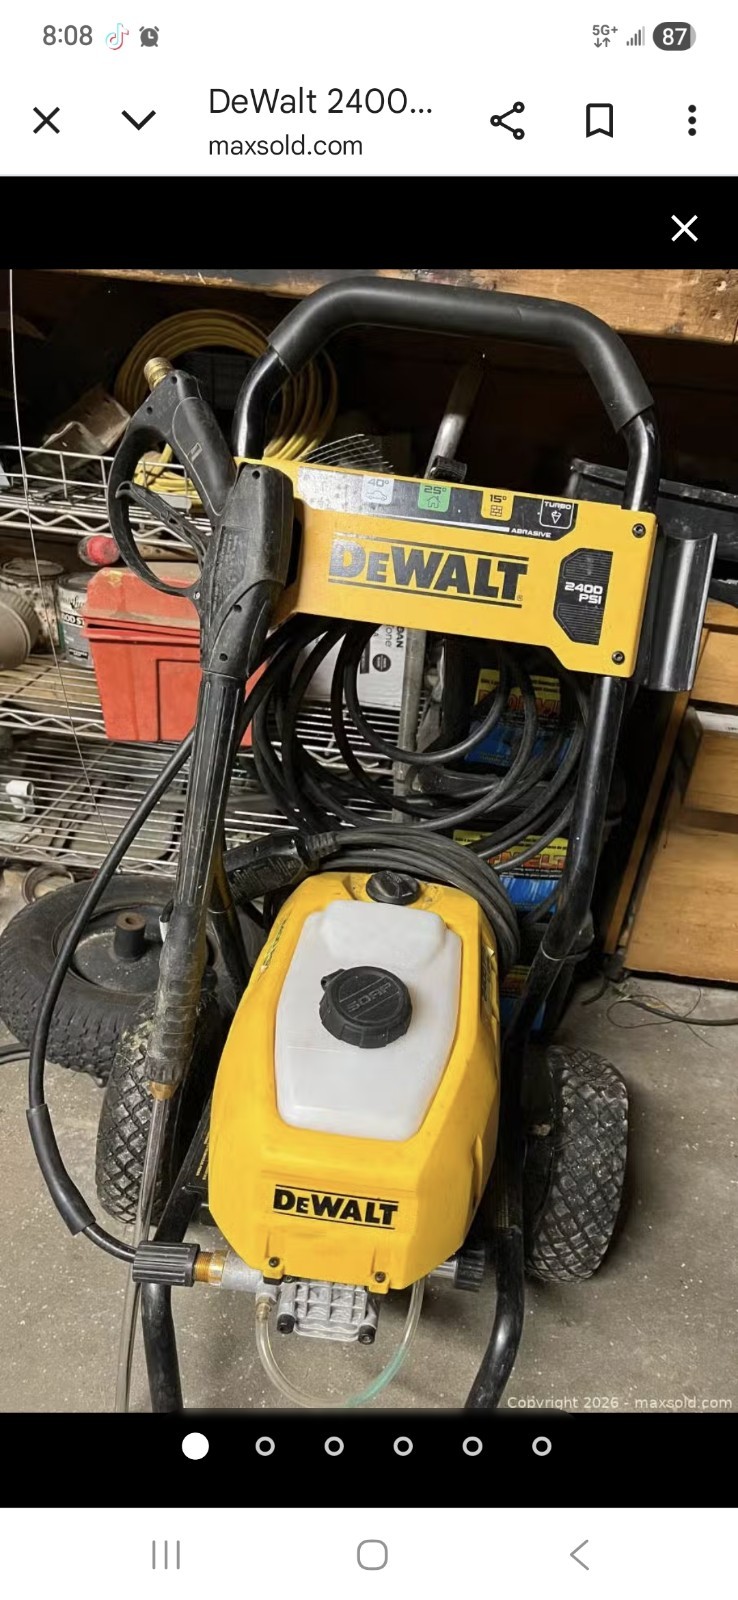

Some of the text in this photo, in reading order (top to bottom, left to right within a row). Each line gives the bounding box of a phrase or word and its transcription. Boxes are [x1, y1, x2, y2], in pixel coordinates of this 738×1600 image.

[43, 24, 93, 46] 8:08
[592, 24, 619, 36] 5G+
[662, 27, 688, 46] 87
[209, 87, 433, 114] DeWalt 2400...
[209, 134, 363, 155] maxsold.com
[424, 485, 447, 495] 25°
[489, 494, 508, 504] 15°
[544, 501, 572, 510] TURBO
[511, 528, 552, 539] ABRASIVE
[564, 581, 604, 595] 2400
[578, 593, 603, 605] PSI
[347, 982, 392, 1013] SOAP
